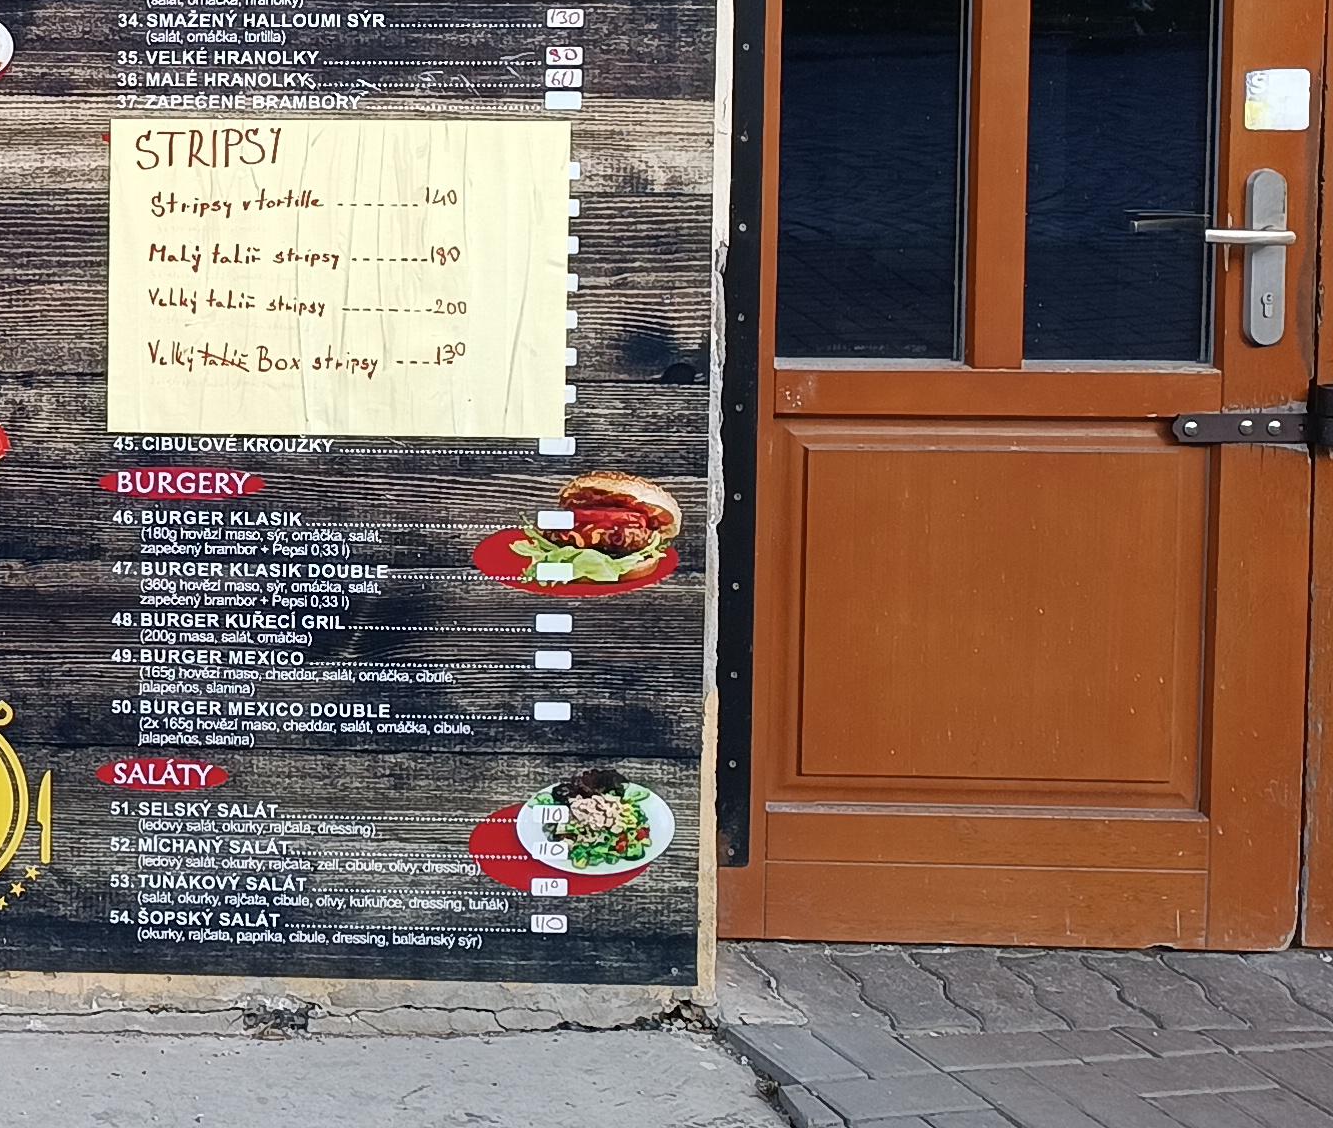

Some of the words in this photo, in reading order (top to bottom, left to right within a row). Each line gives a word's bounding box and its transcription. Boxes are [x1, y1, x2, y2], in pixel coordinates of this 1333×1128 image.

[118, 14, 144, 27] 34.
[146, 8, 238, 28] SMAŽENÝ
[243, 13, 341, 28] HALLOUMI
[348, 9, 385, 27] SÝR
[134, 127, 282, 170] STRIPSY
[114, 436, 139, 451] 45.
[142, 434, 237, 452] CIBULOVÉ
[243, 434, 334, 454] KROUŽKY
[116, 470, 250, 495] BURGERY
[113, 511, 138, 525] 46.
[141, 511, 224, 526] BURGER
[231, 511, 303, 527] KLASIK
[112, 613, 137, 628] 48.
[140, 613, 220, 629] BURGER
[225, 610, 297, 629] KUŘECÍ
[302, 615, 346, 630] GRIL
[111, 700, 136, 714] 50.
[139, 701, 221, 716] BURGER
[228, 702, 303, 717] MEXICO
[310, 703, 390, 718] DOUBLE
[114, 759, 213, 787] SALÁTY
[110, 802, 135, 815] 51.
[137, 799, 210, 817] SELSKÝ
[218, 799, 278, 819] SALÁT
[110, 874, 135, 888] 53.
[138, 871, 240, 891] TUŇÁKOVÝ
[246, 873, 307, 891] SALÁT
[109, 911, 134, 924] 54.
[138, 907, 212, 927] ŠOPSKÝ
[219, 909, 280, 928] SALÁT
